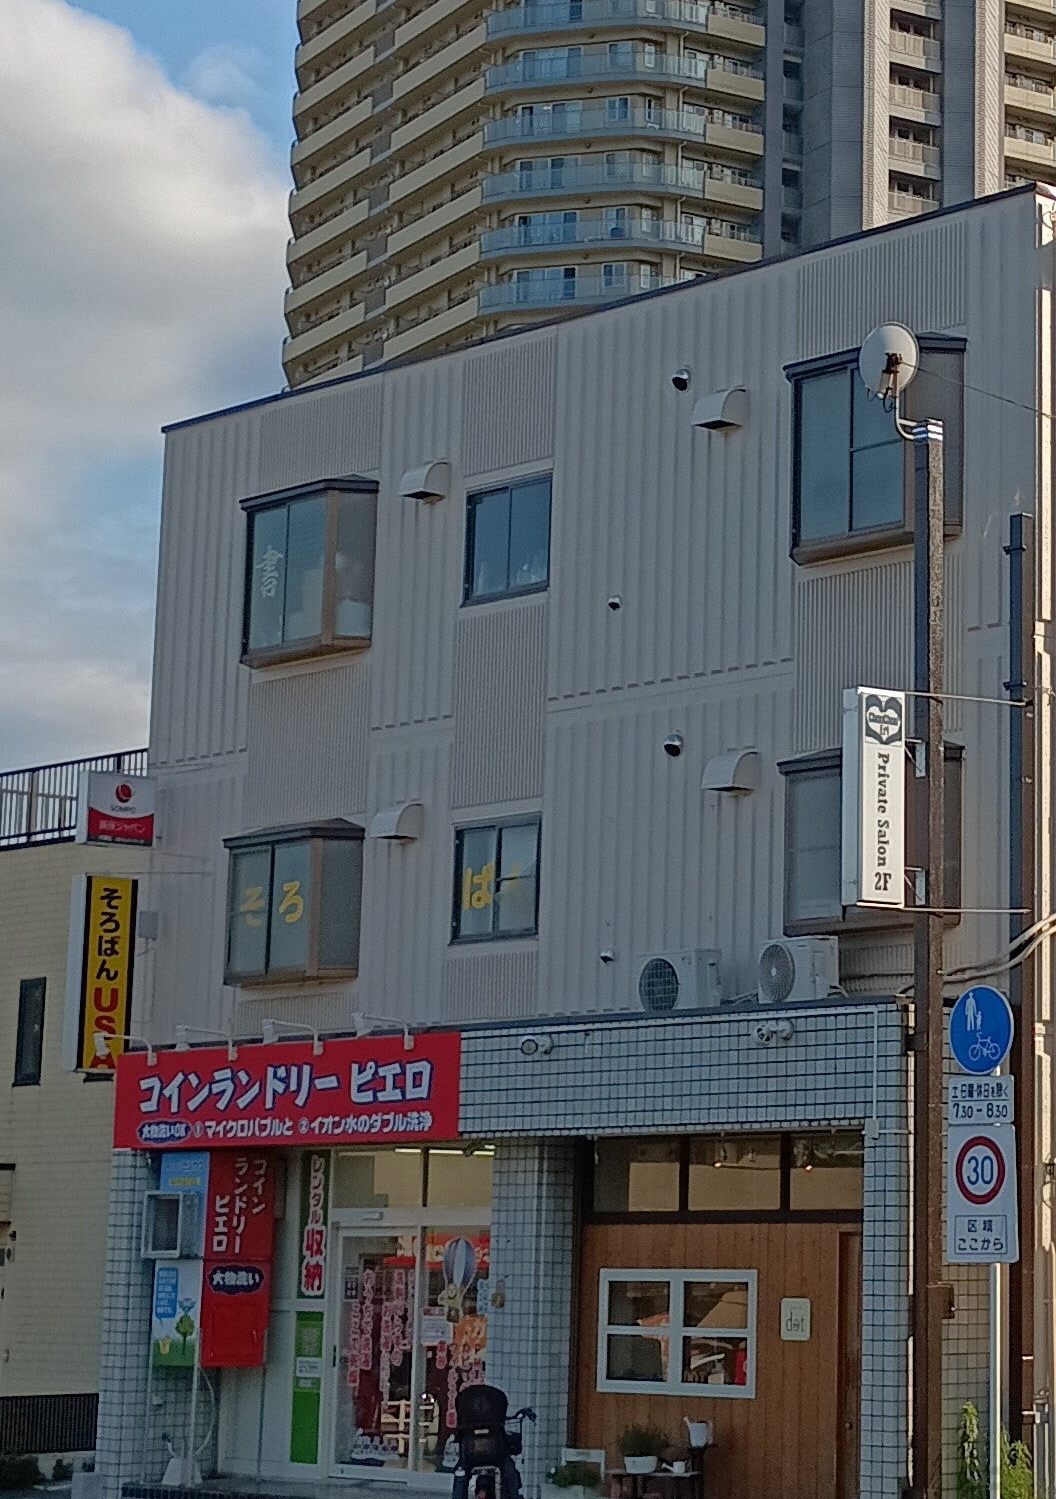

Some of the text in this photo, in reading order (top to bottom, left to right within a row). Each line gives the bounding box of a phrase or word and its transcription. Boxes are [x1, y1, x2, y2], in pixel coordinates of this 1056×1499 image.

[874, 752, 892, 891] Private Salon 2F
[138, 1059, 432, 1114] コインランドリー ピエロ
[252, 1159, 267, 1214] コイン
[967, 1155, 994, 1185] 30
[212, 1194, 230, 1252] ピエロ
[233, 1157, 248, 1254] ランドリー
[967, 1219, 994, 1233] 区域
[957, 1237, 1004, 1251] ここから
